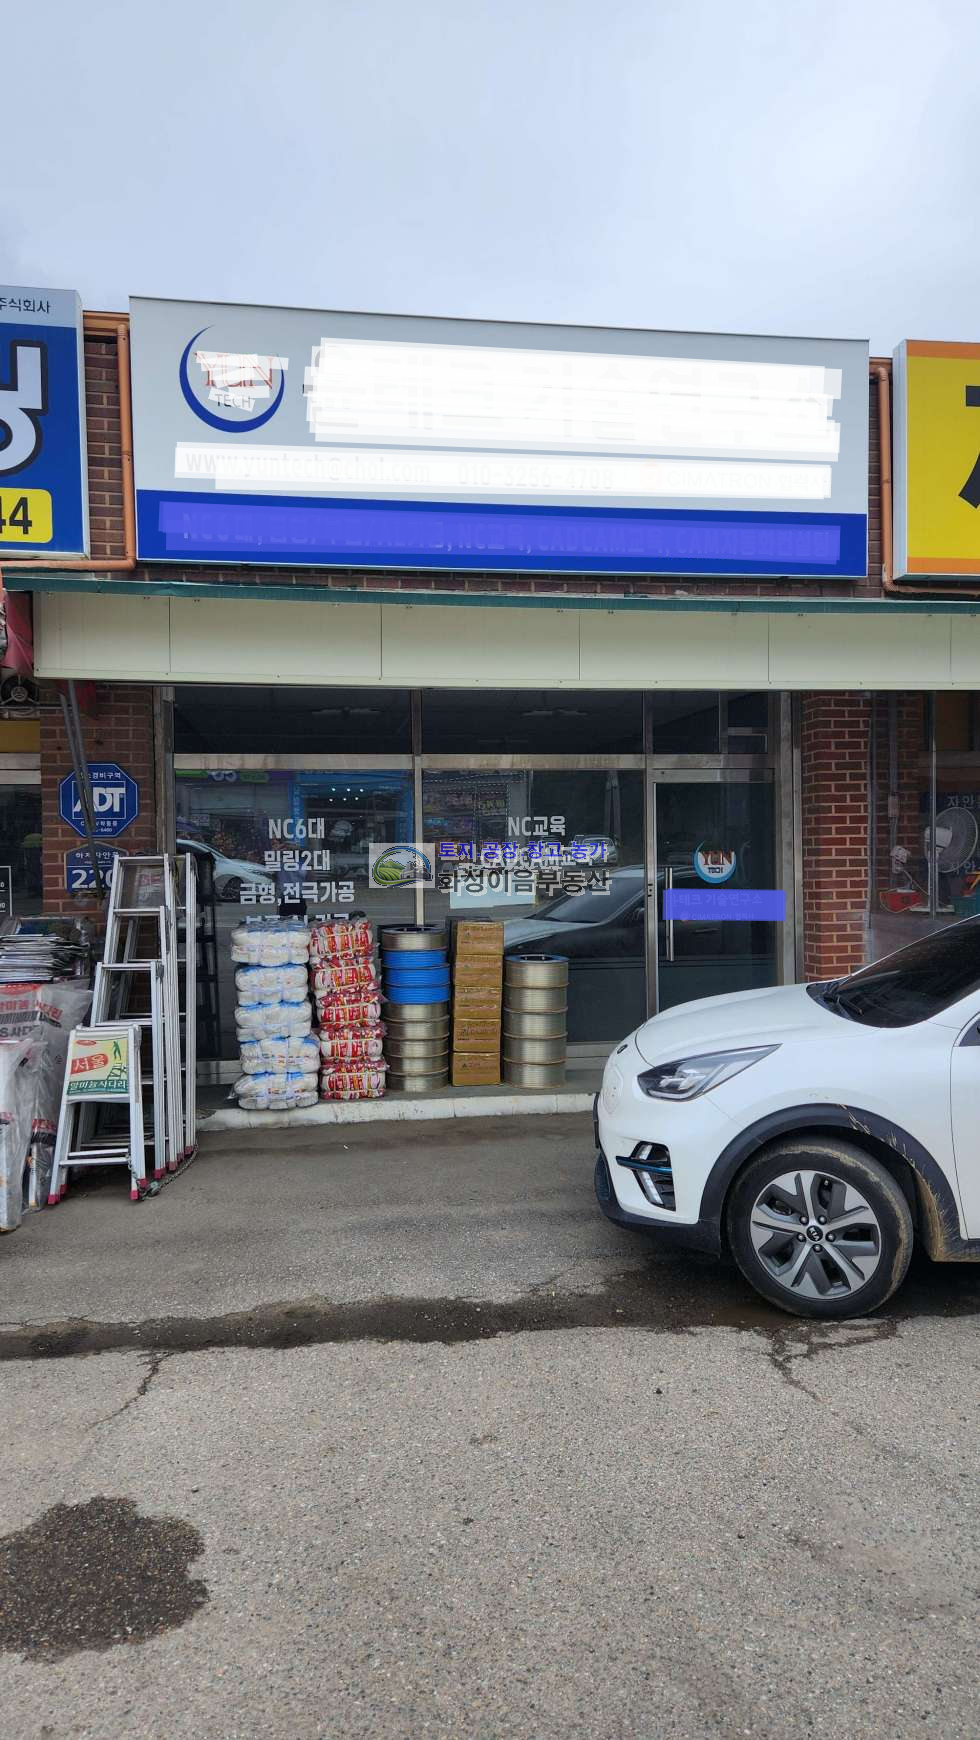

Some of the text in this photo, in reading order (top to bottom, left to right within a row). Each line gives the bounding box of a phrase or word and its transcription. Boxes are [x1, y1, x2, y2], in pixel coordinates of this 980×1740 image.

[268, 817, 325, 839] NC6대
[507, 815, 566, 837] NC교육
[264, 849, 330, 872] 밀링2대
